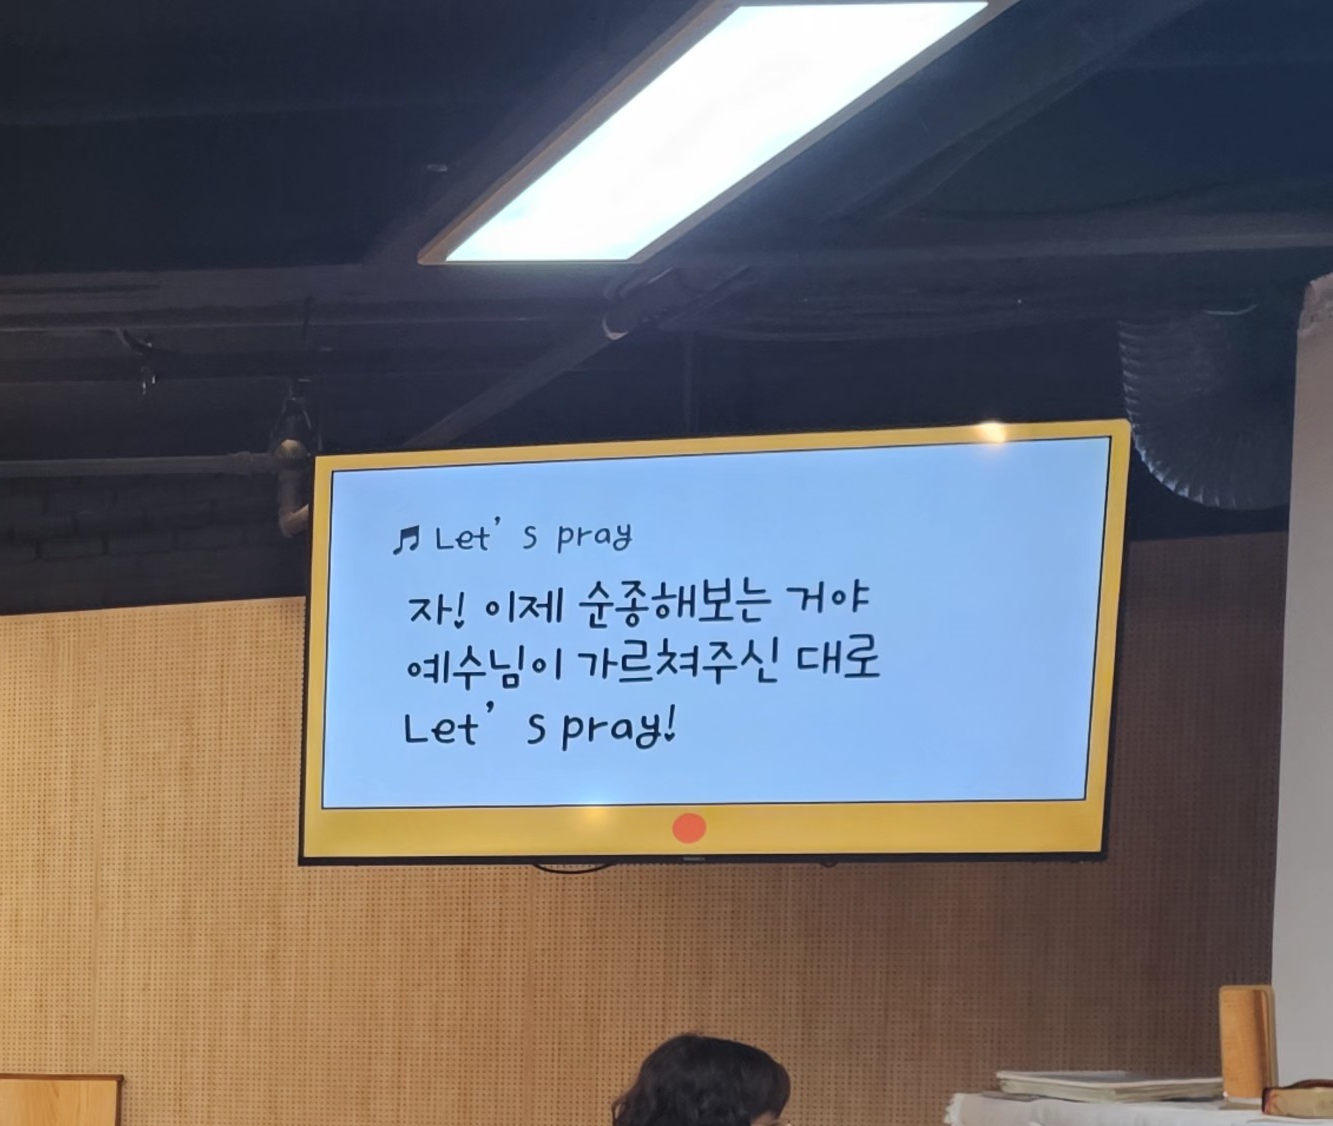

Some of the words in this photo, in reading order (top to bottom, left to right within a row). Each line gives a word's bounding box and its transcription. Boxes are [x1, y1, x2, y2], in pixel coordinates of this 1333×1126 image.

[557, 523, 632, 554] pray
[408, 591, 465, 631] 자!
[485, 586, 564, 623] 이제
[578, 577, 772, 629] 순종해보는
[786, 578, 870, 615] 거야
[407, 642, 562, 691] 예수님이
[577, 636, 779, 687] 가르쳐주신
[797, 633, 881, 679] 대로
[561, 703, 677, 752] pray!
